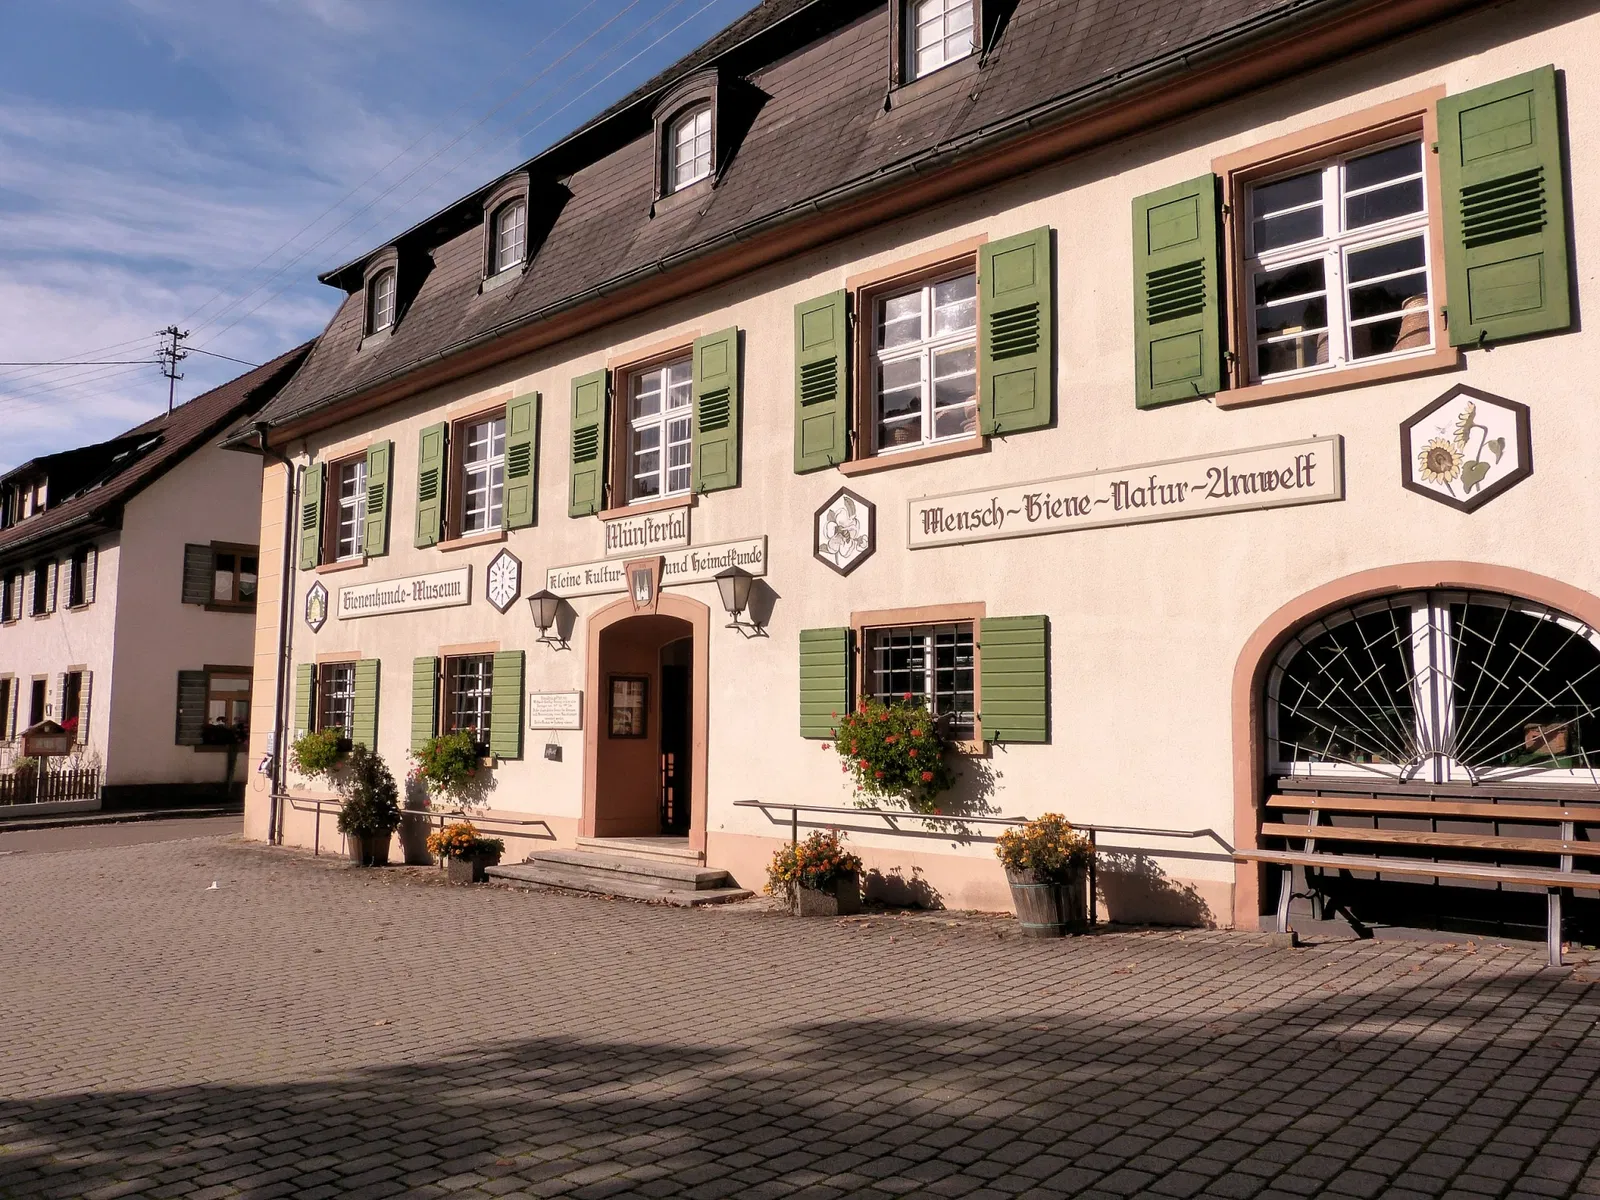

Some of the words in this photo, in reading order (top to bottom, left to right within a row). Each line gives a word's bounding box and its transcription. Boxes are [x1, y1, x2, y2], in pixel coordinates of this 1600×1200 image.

[550, 573, 581, 589] Kleine
[585, 564, 626, 584] Kultur-
[664, 554, 688, 575] und
[691, 545, 763, 573] Heimatkunde
